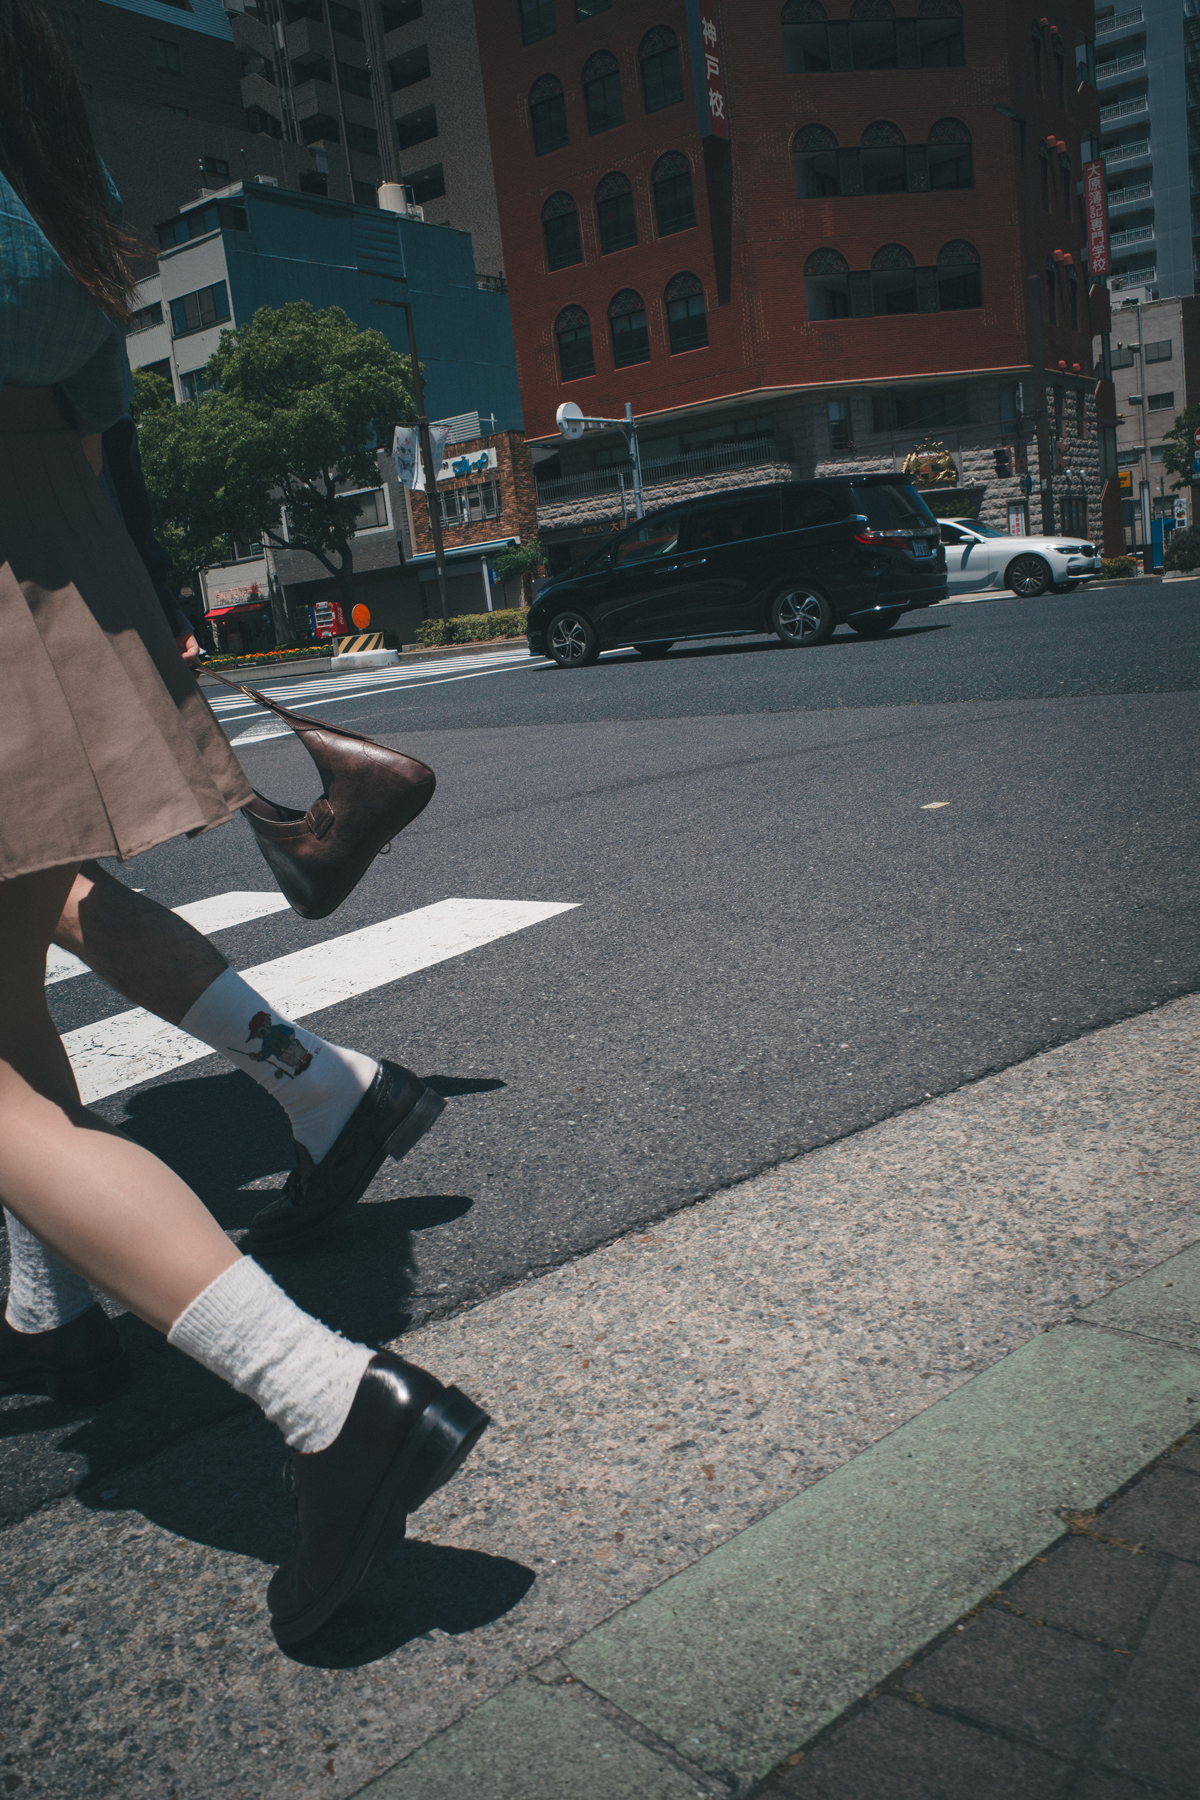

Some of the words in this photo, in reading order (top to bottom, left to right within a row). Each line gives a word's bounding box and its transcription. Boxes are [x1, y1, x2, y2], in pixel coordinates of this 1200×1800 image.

[701, 16, 725, 120] 神戸校
[1086, 163, 1107, 273] 大原簿記専門学校
